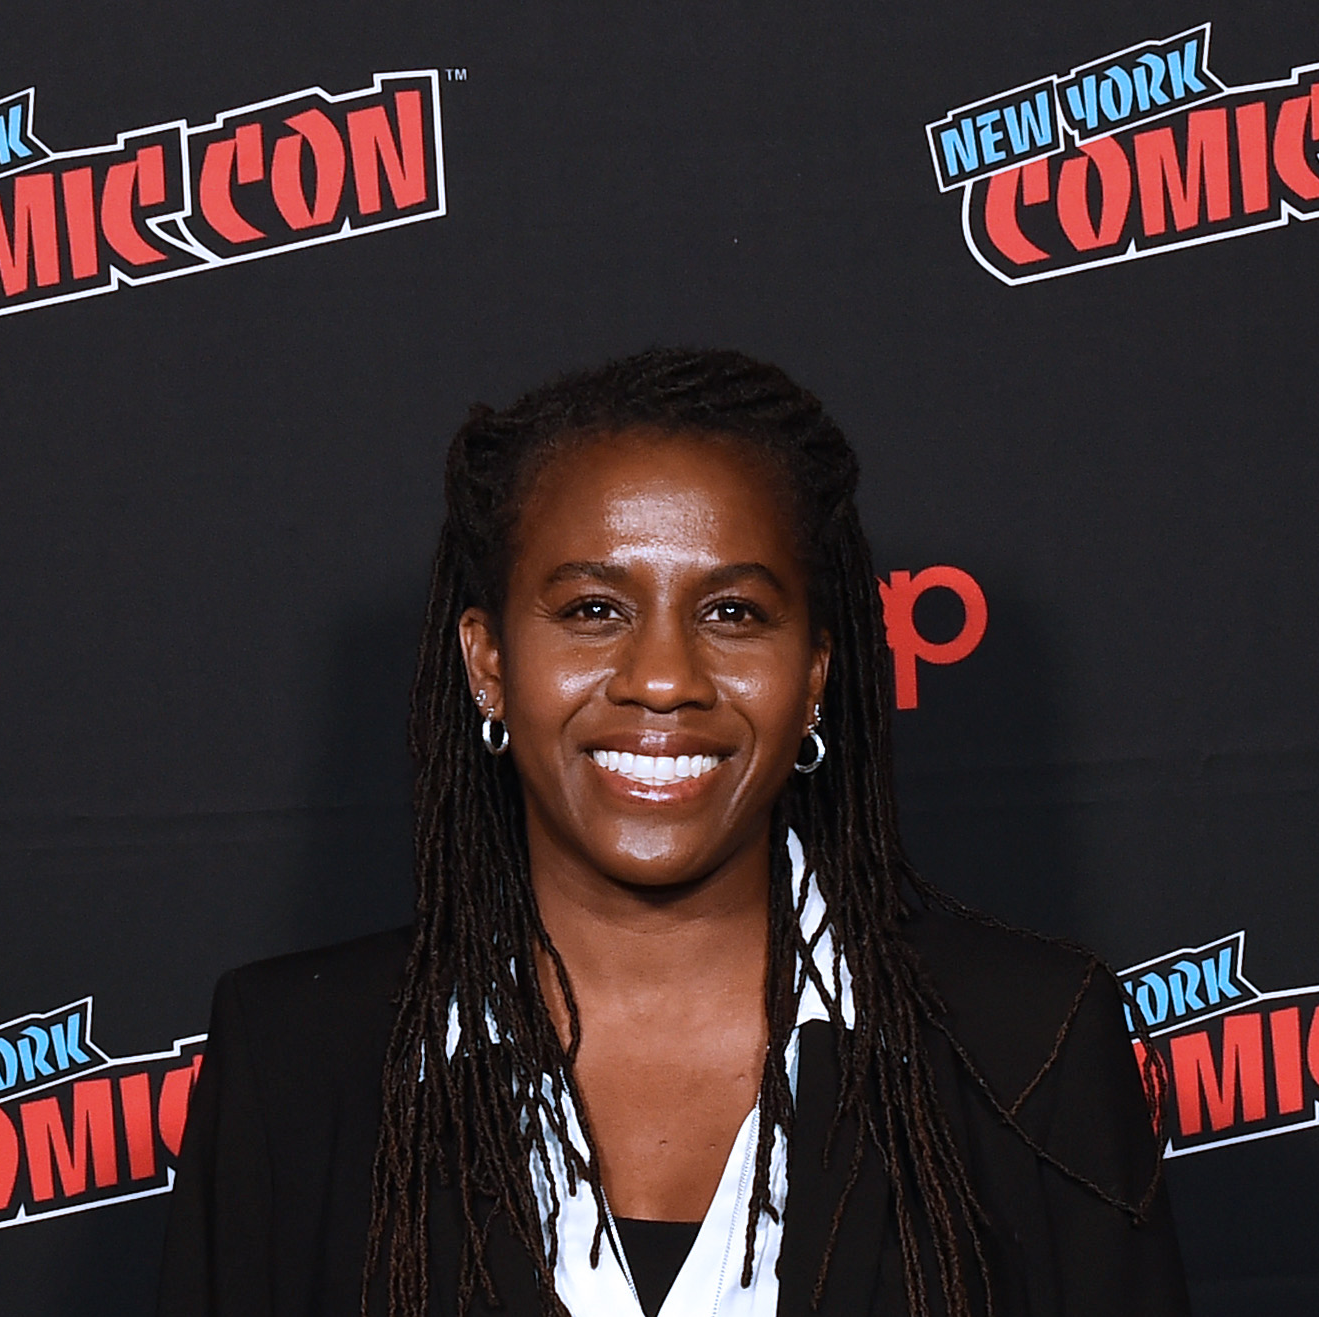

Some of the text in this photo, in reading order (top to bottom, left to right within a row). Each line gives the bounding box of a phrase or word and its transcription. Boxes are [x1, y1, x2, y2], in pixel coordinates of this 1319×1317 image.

[199, 89, 427, 244] CON
[940, 40, 1206, 177] NEW YORK
[1123, 946, 1242, 1033] ORK
